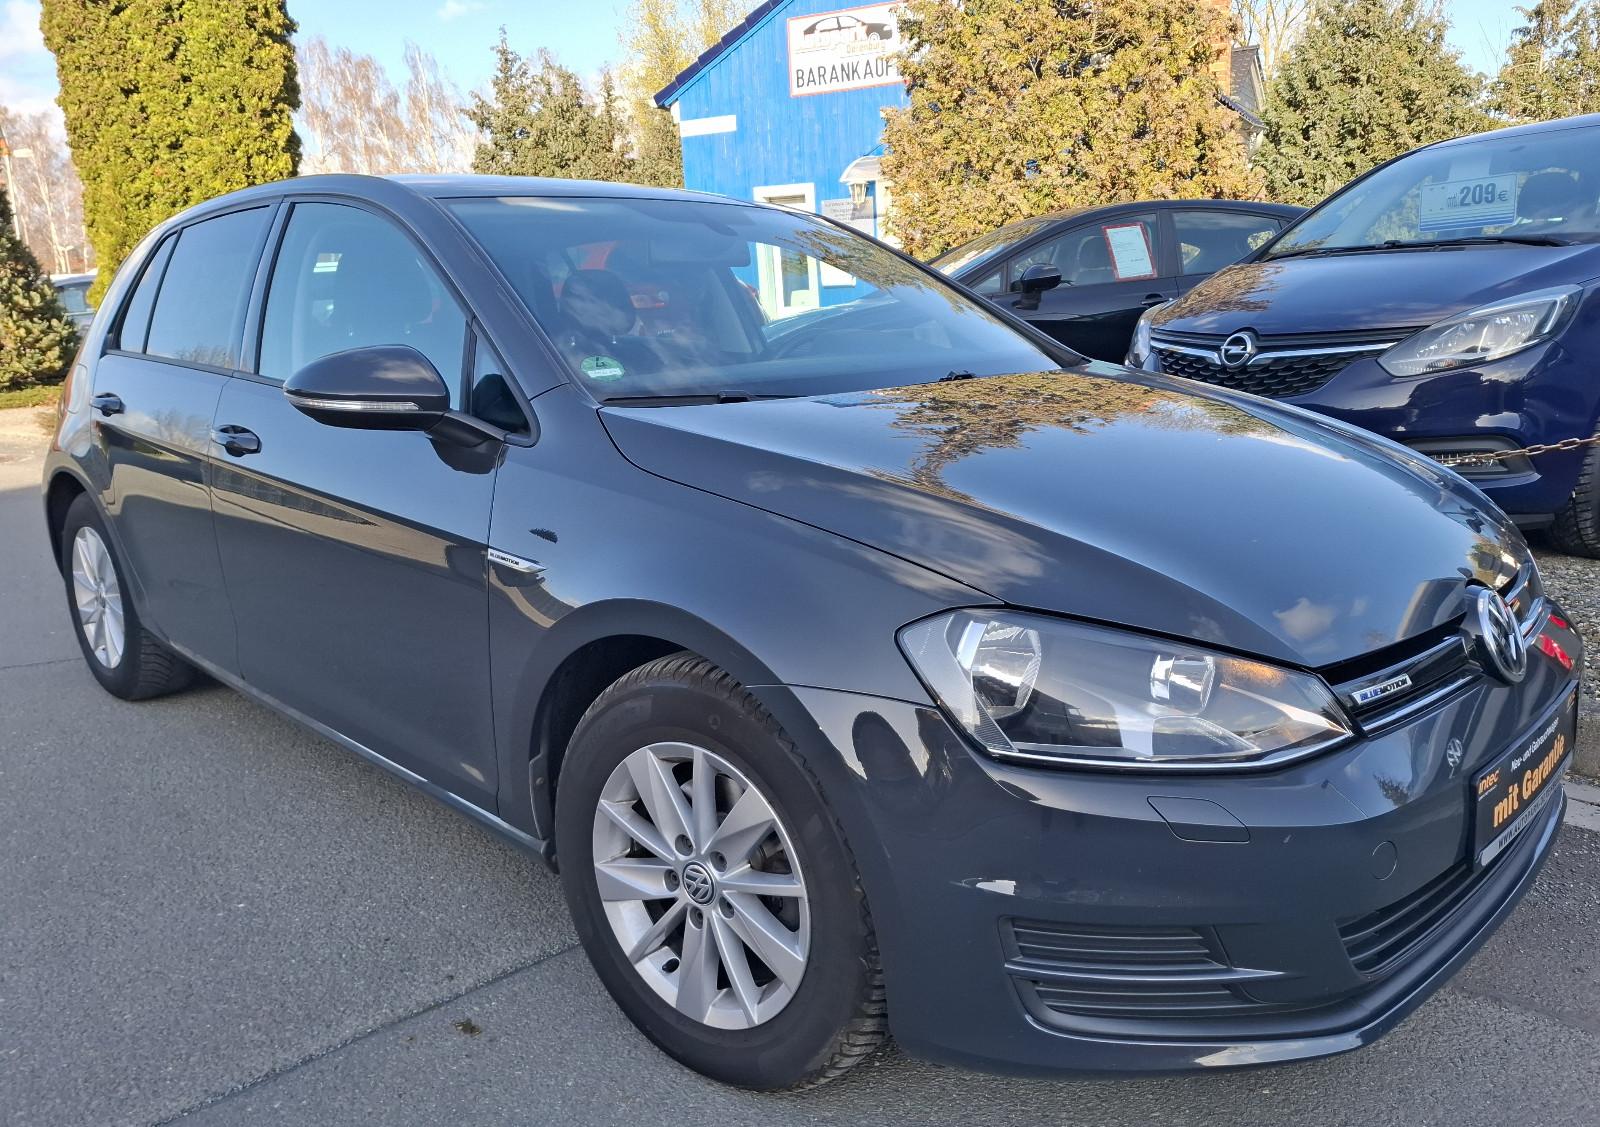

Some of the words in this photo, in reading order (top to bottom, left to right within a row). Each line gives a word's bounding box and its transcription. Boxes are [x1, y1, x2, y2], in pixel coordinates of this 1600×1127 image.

[795, 58, 893, 88] BARANKAUF
[489, 551, 520, 566] BLUEMOTION
[1359, 675, 1409, 701] BLUEMOTION
[1493, 782, 1519, 828] mit
[1522, 733, 1565, 800] Garantie
